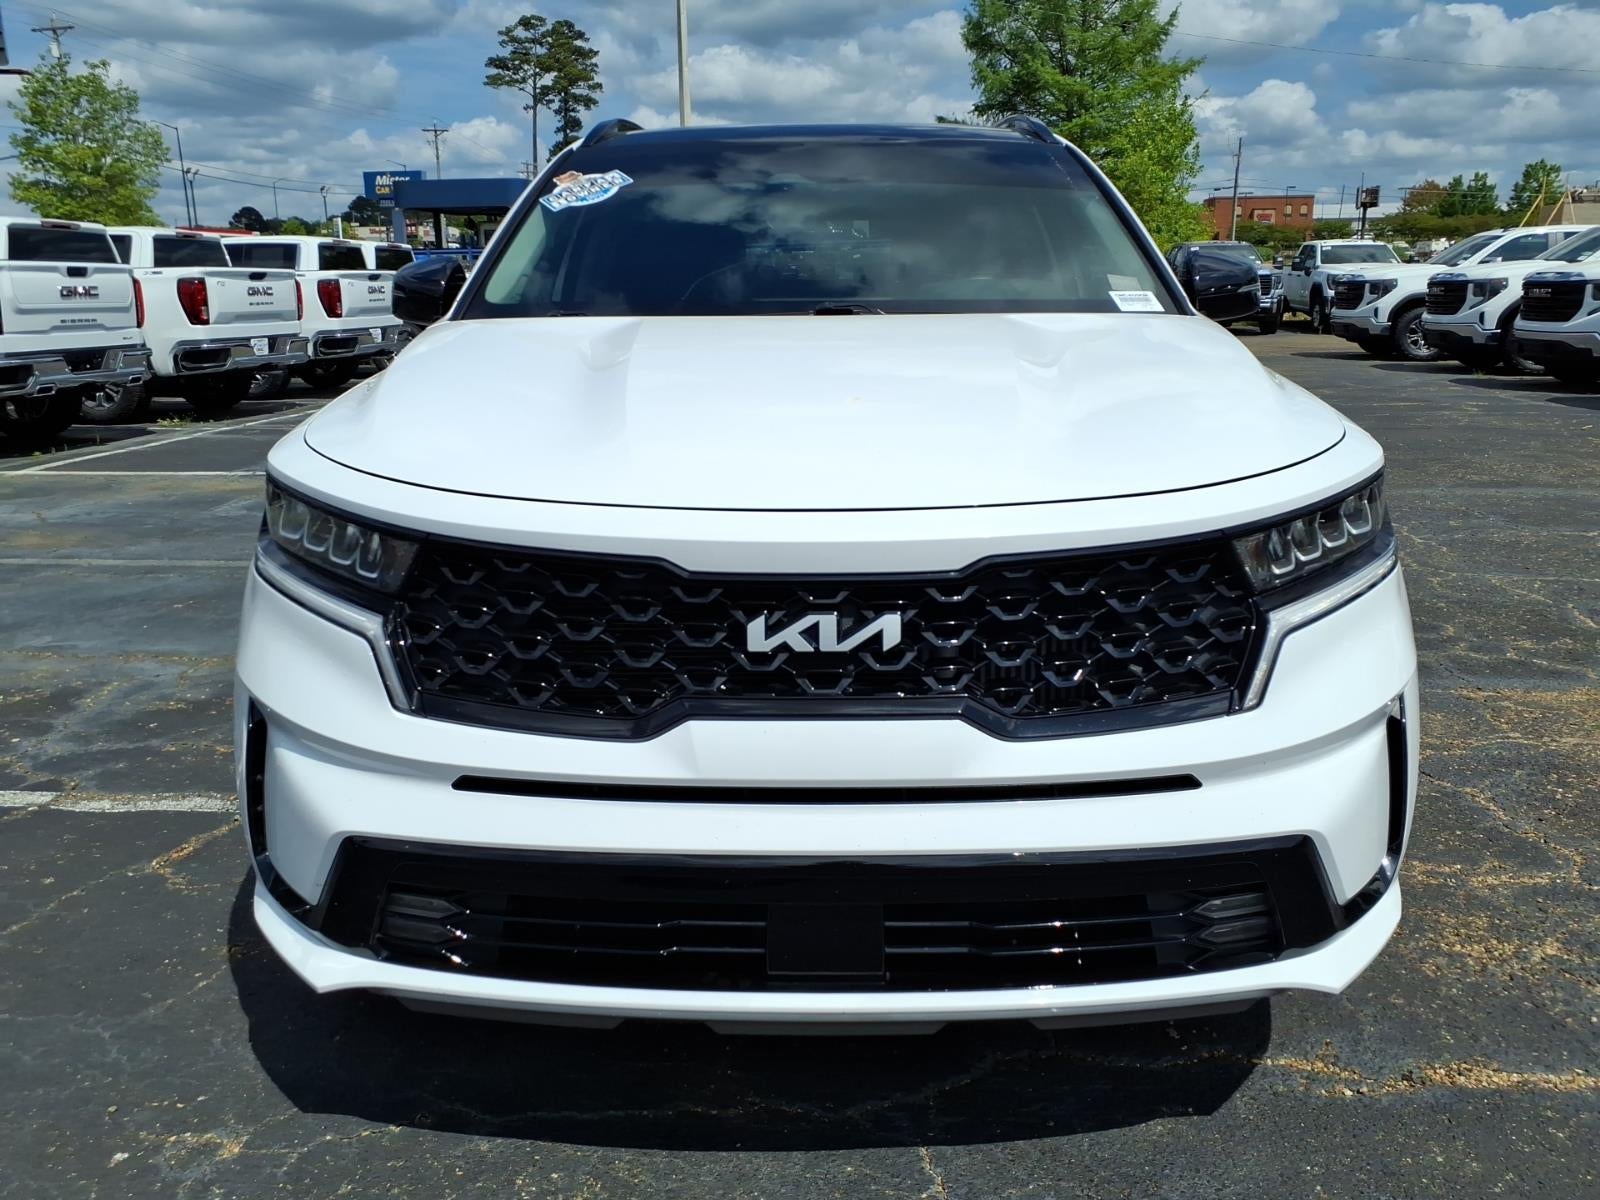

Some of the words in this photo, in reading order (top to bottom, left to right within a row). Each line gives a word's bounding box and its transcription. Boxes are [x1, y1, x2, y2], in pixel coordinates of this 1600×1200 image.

[60, 286, 99, 297] GMC
[247, 286, 274, 296] GMC
[747, 612, 902, 652] KIA
